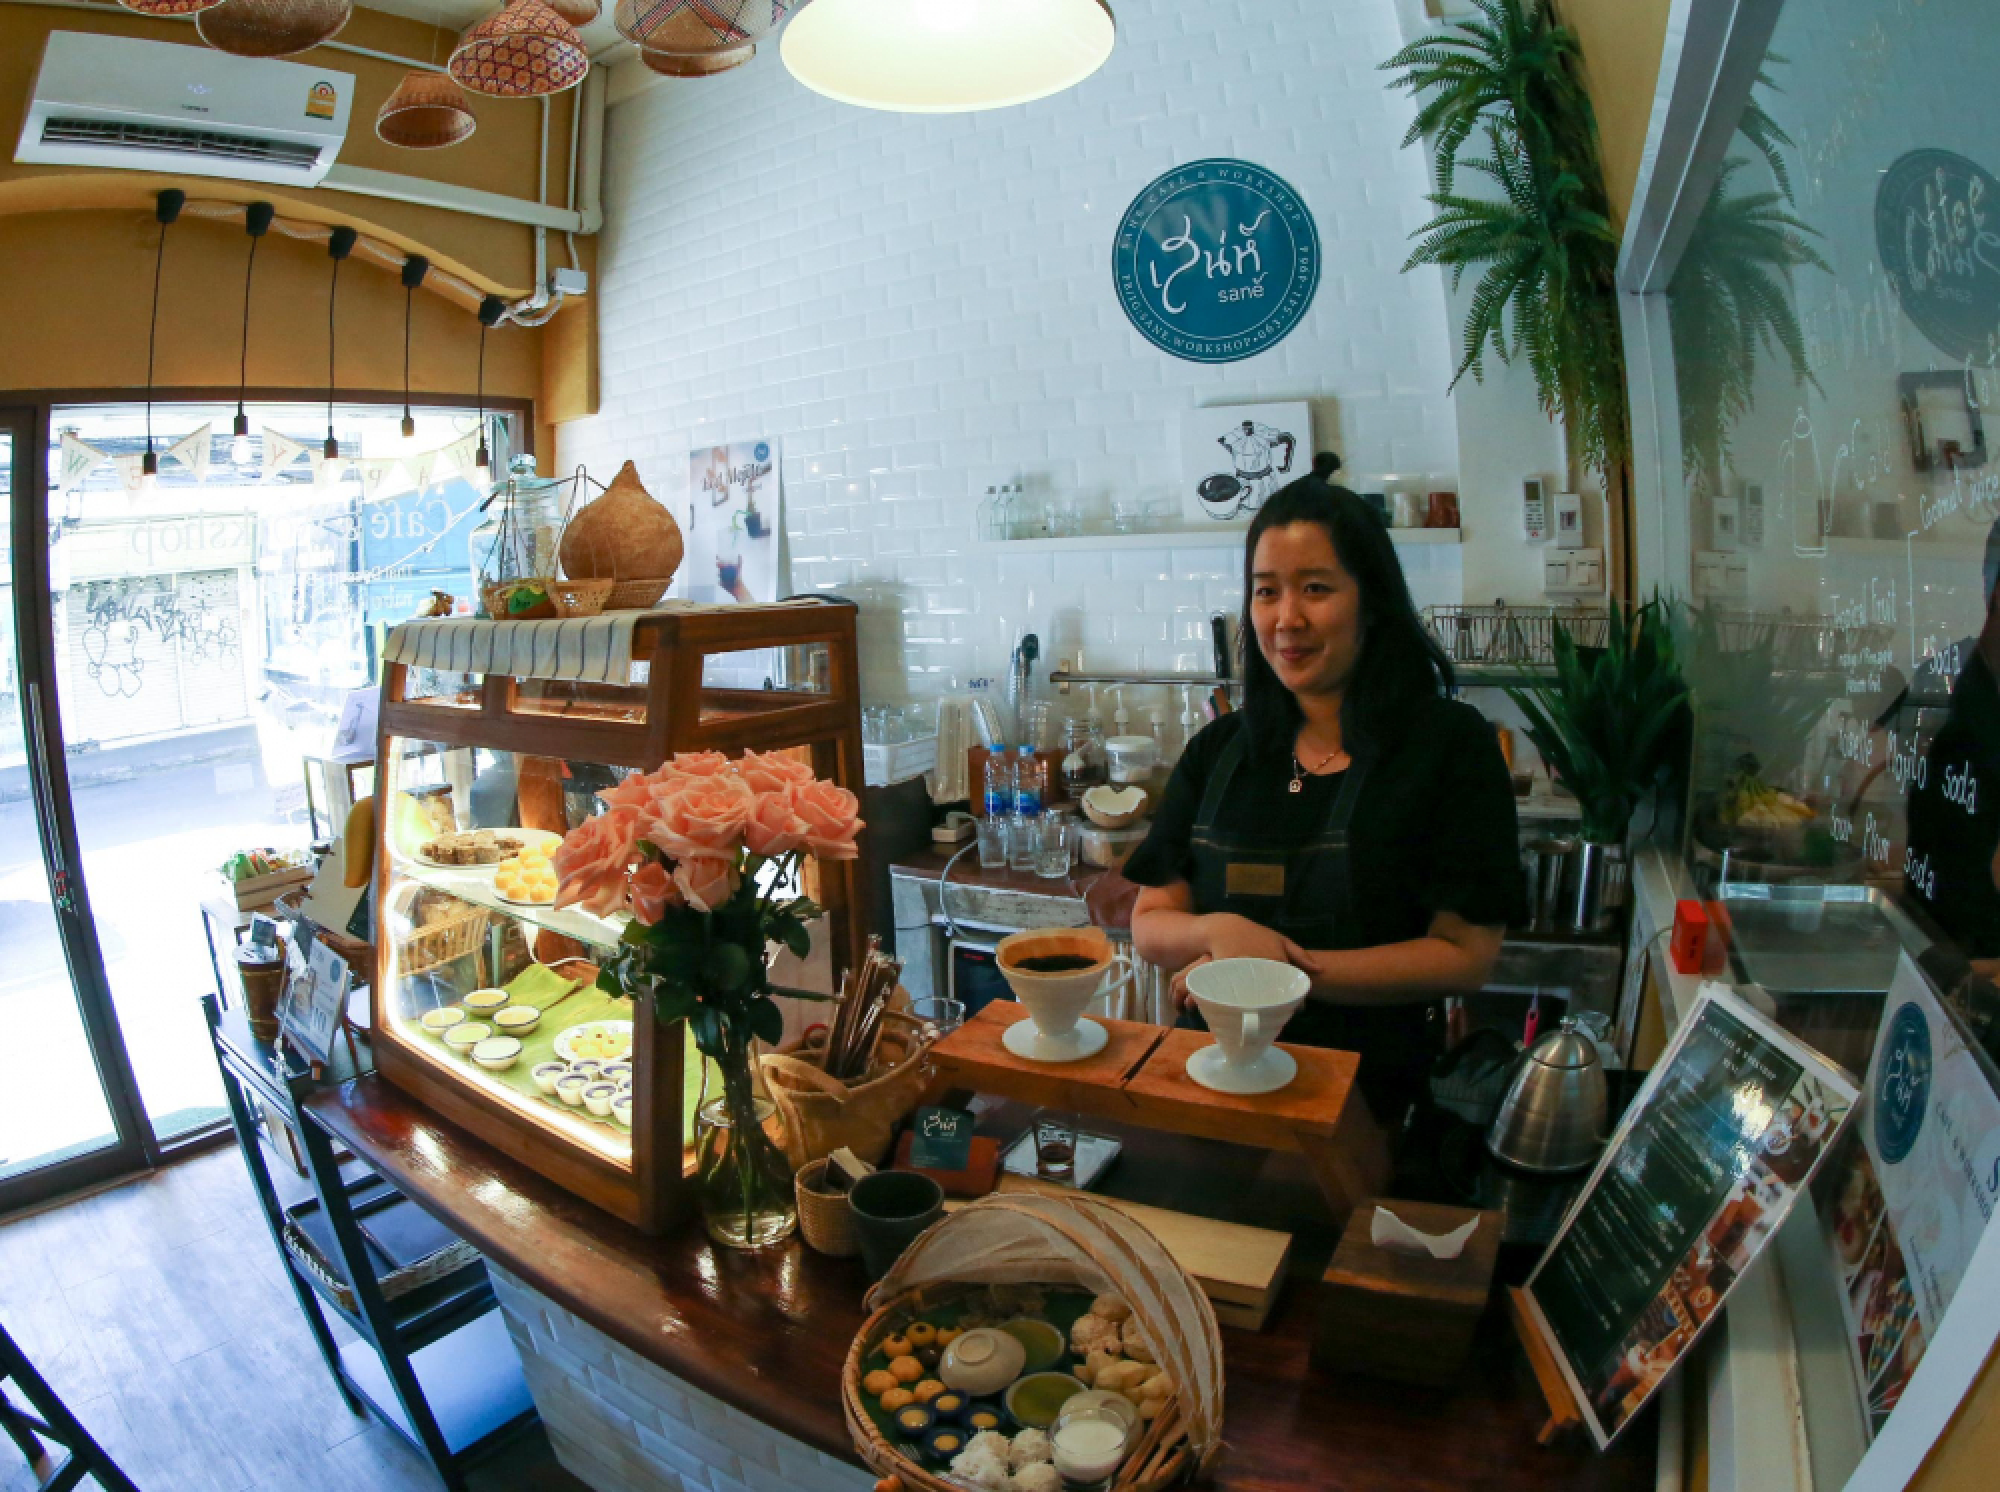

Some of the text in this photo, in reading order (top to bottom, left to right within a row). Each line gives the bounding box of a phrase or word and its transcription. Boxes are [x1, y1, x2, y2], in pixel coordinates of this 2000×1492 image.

[1217, 271, 1269, 304] sané
[1941, 759, 1977, 815] Soda
[1904, 847, 1935, 900] Soda
